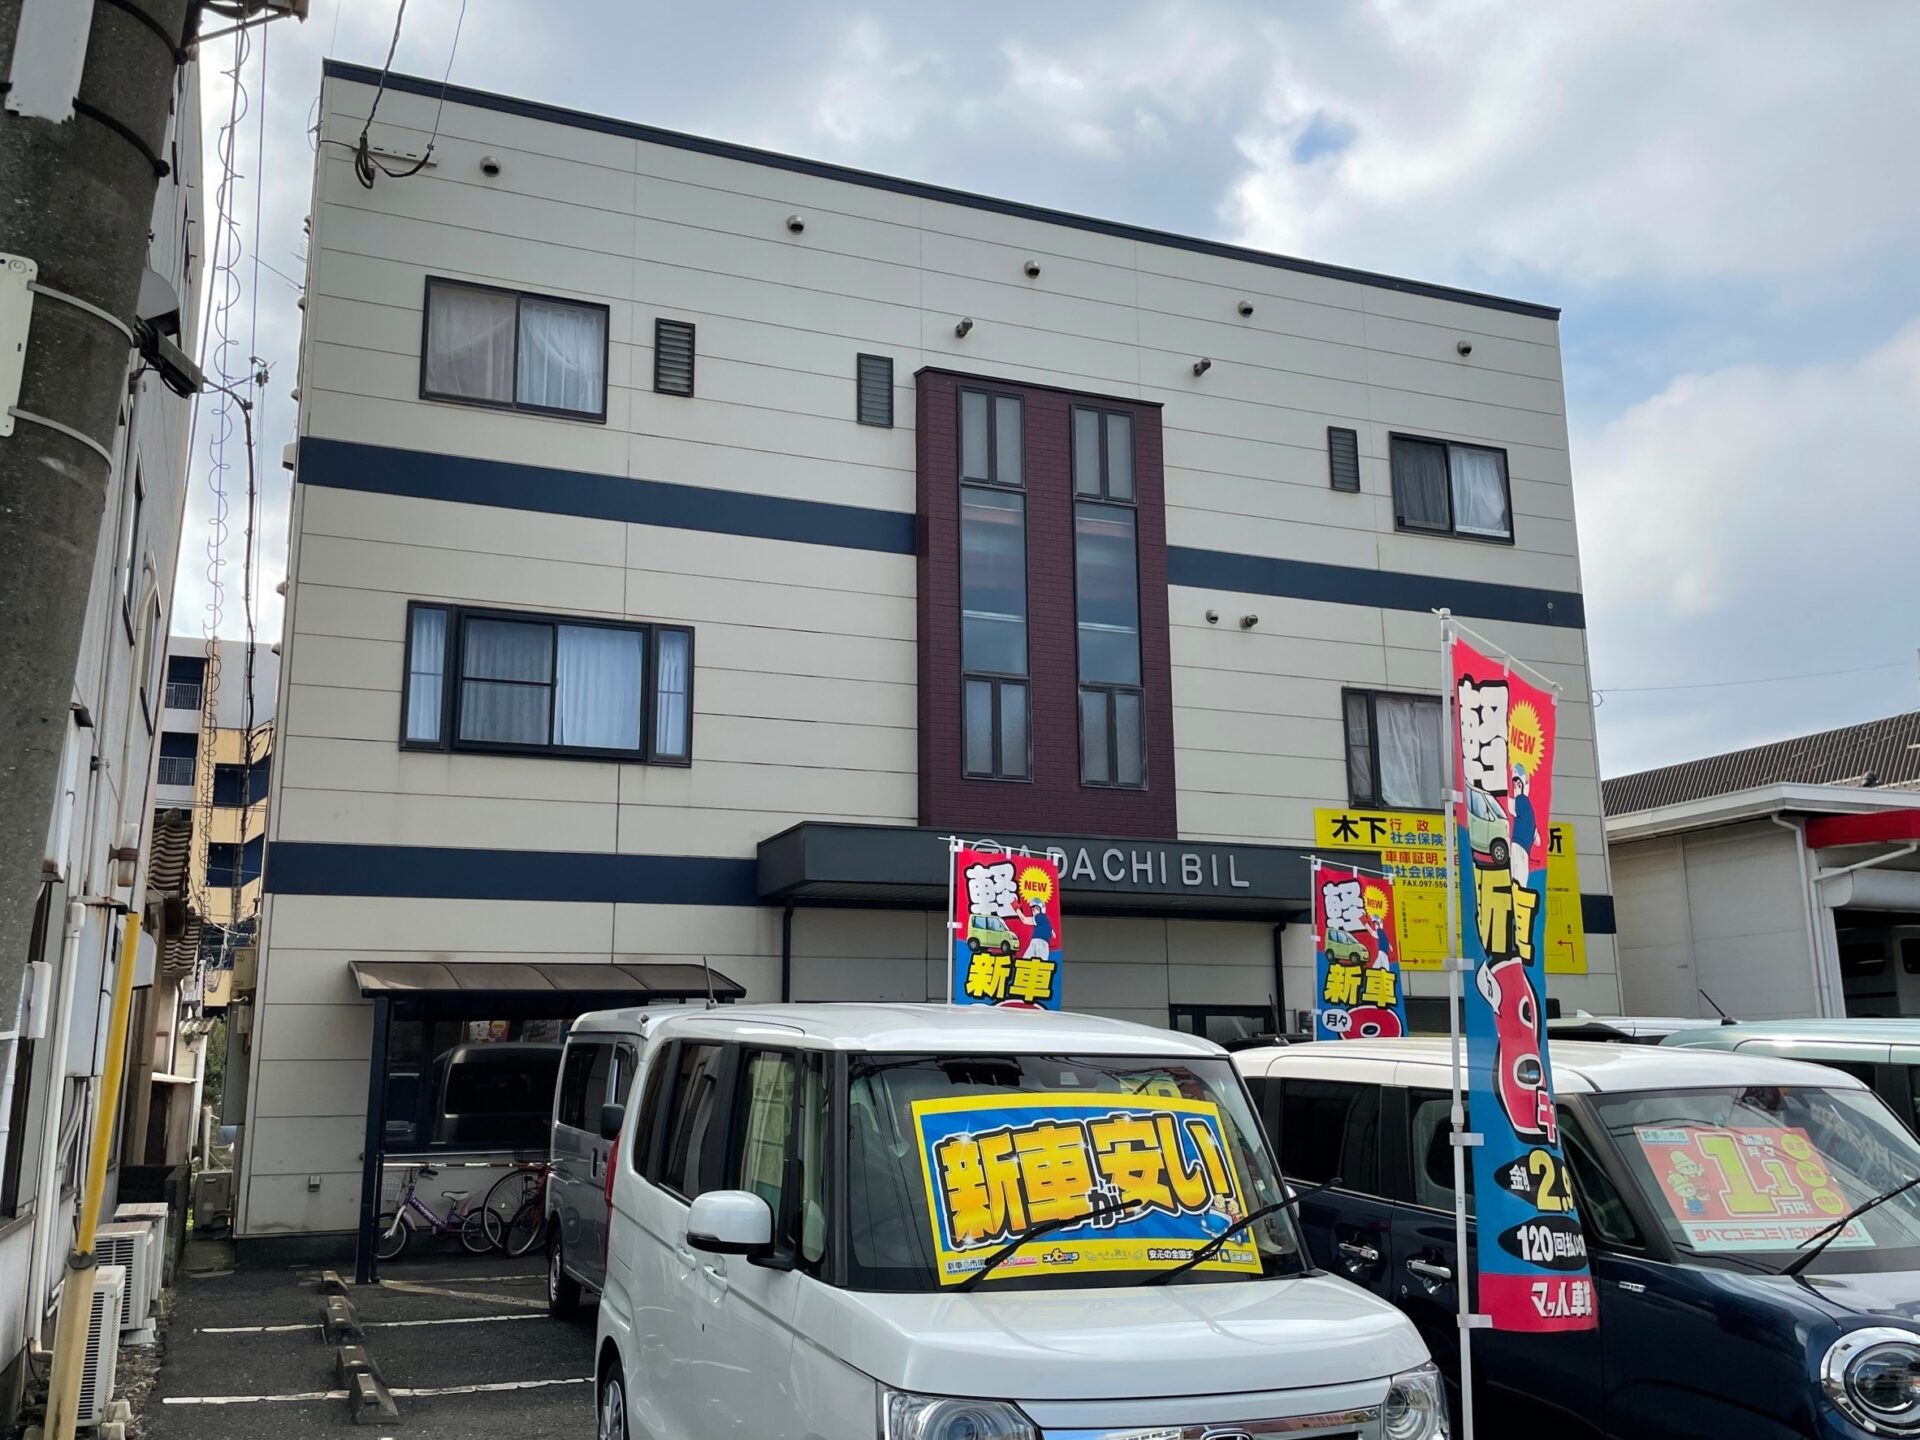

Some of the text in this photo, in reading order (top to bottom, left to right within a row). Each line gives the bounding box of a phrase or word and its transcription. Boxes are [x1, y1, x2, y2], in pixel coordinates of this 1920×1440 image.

[1510, 726, 1535, 755] NEW
[1331, 815, 1386, 844] 木下
[1390, 832, 1456, 847] 社会保険
[1181, 853, 1250, 888] BIL
[966, 863, 1018, 917] 軽
[1024, 880, 1047, 892] NEW
[1323, 881, 1367, 931] 軽
[1367, 898, 1383, 909] NEW
[965, 954, 1055, 1001] 新車
[1324, 964, 1397, 1008] 新車
[1326, 1013, 1348, 1027] 月々
